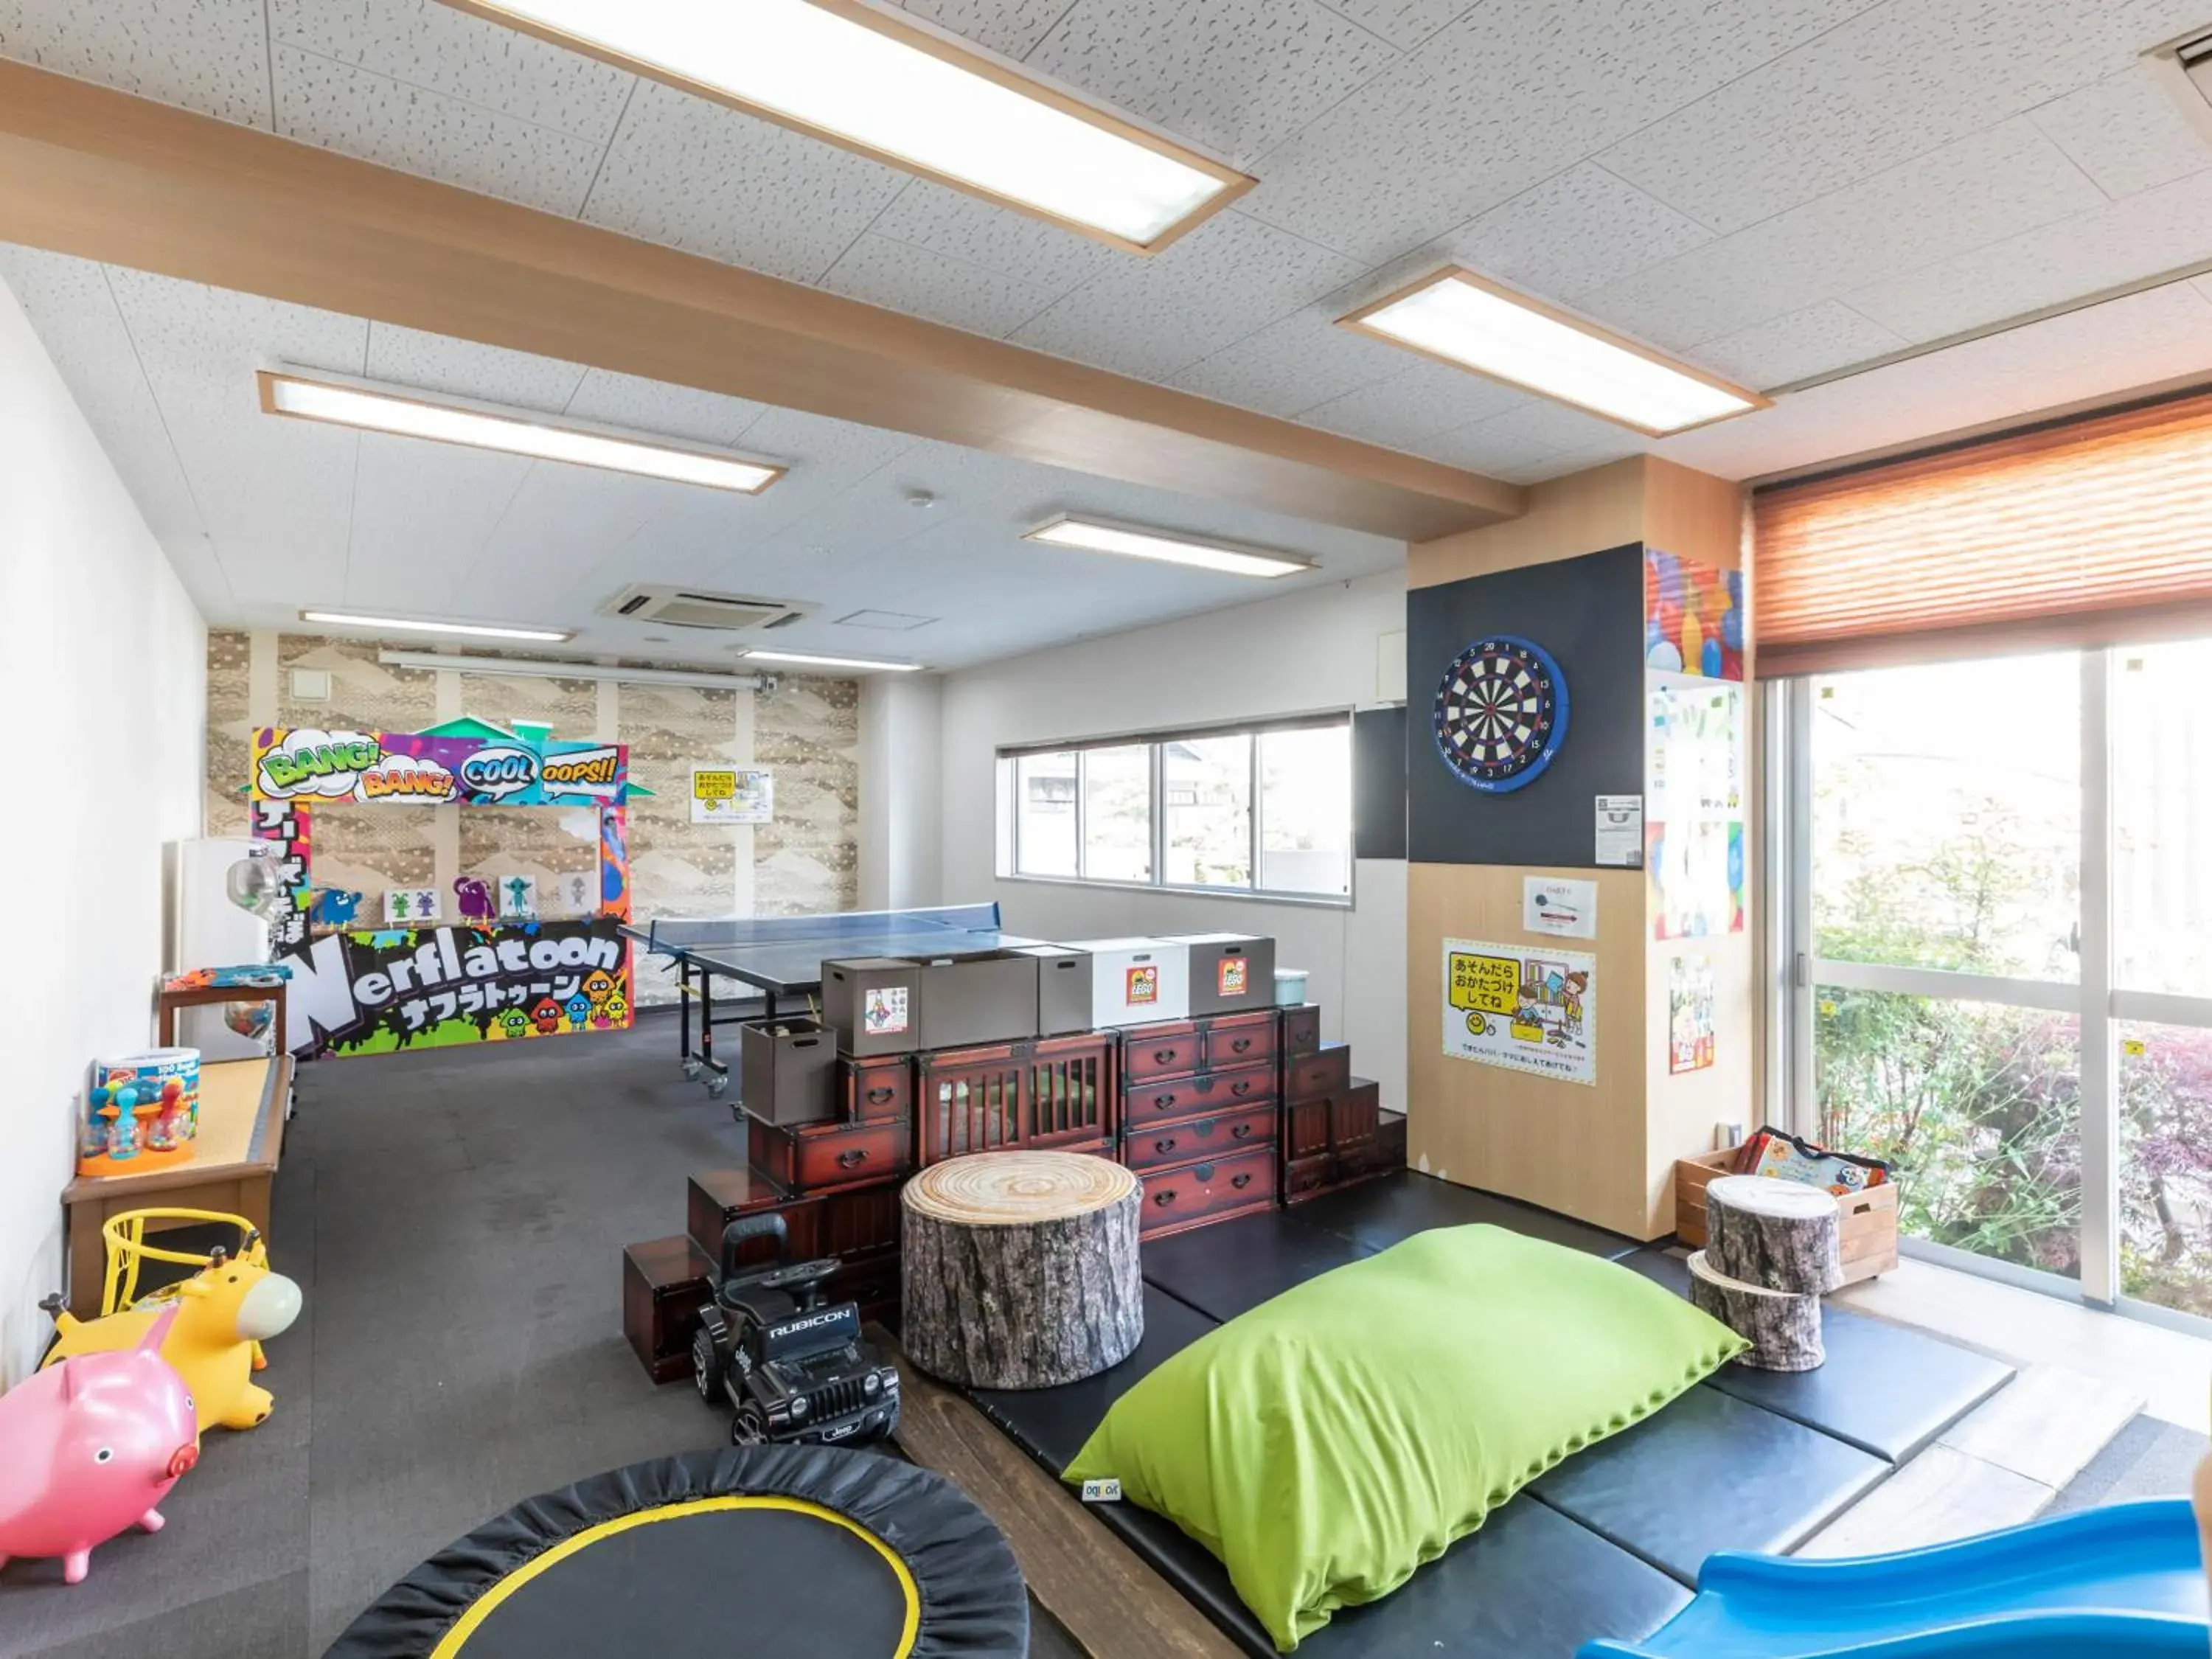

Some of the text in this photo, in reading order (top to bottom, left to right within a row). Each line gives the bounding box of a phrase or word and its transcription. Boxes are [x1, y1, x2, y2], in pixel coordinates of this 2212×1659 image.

[1469, 648, 1475, 656] 5
[1485, 642, 1495, 651] 20
[1545, 700, 1551, 709] 6
[1531, 740, 1540, 748] 15
[262, 742, 380, 788] BANG!
[1520, 755, 1526, 763] 2
[465, 755, 534, 784] COOL
[541, 757, 617, 782] OOPS!!
[1487, 768, 1493, 777] 3
[1503, 765, 1512, 773] 17
[361, 770, 453, 798] BANG!
[1455, 959, 1514, 978] あそんだら
[286, 927, 619, 1052] Nerflatoon
[1132, 982, 1153, 995] LEGO
[1455, 975, 1514, 994] おかたづけ
[400, 975, 580, 1029] ナフラトゥーン
[1468, 990, 1502, 1008] してね
[769, 1309, 850, 1339] RUBICON
